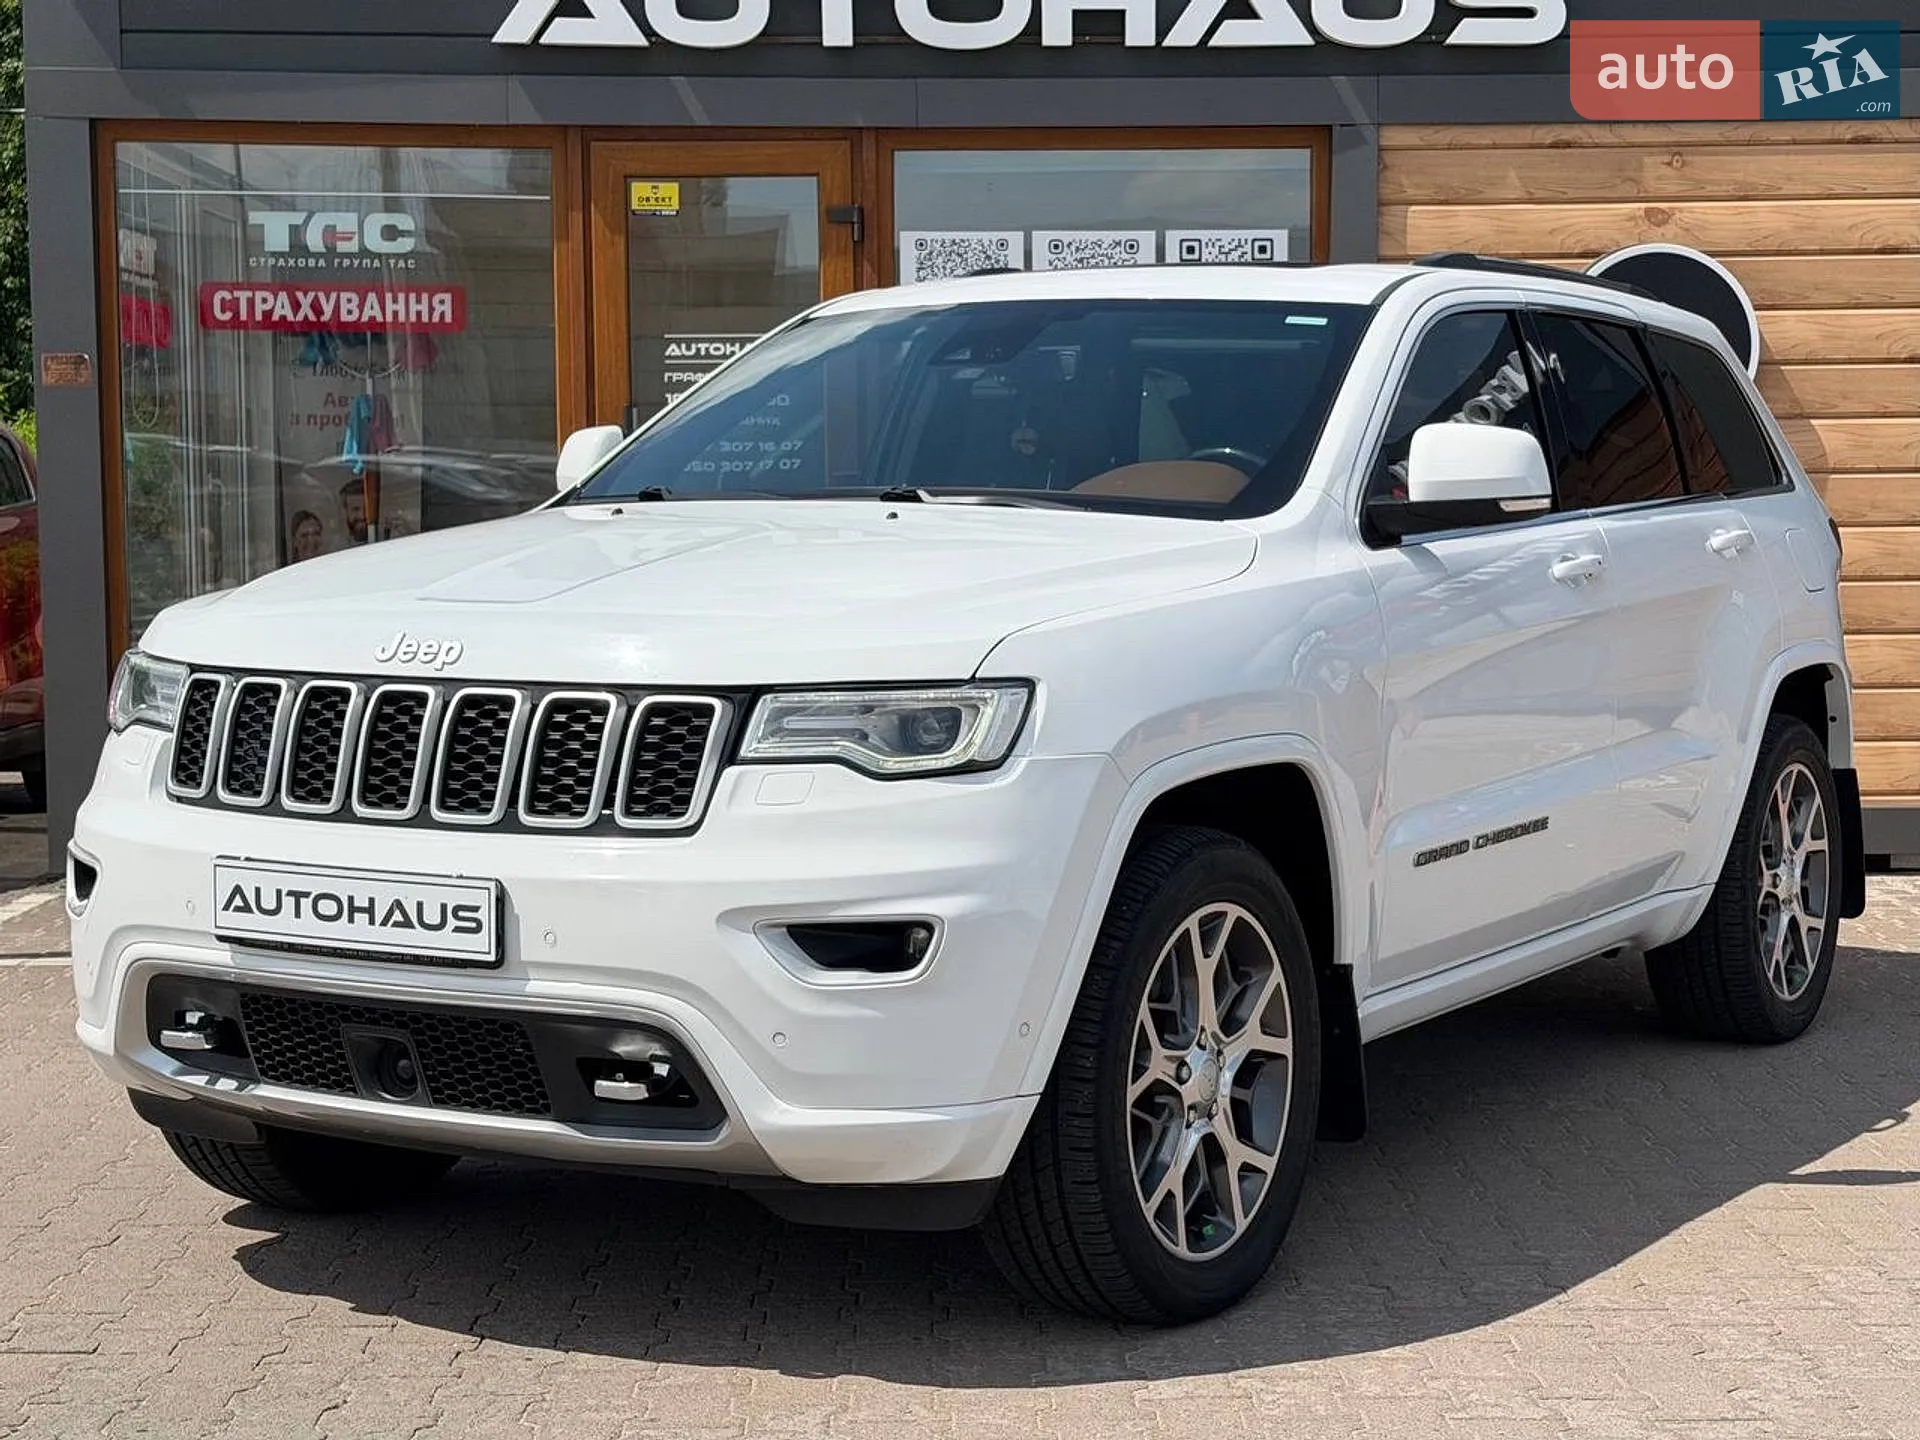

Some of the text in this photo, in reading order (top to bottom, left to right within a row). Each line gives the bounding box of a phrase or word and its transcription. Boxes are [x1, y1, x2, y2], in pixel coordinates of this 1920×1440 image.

[249, 256, 417, 269] СТРАХОВА ГРУПА ТАС
[212, 290, 453, 324] СТРАХУВАННЯ
[374, 629, 464, 671] Jeep
[1413, 815, 1550, 868] GRAND CHEROKEE
[221, 883, 484, 935] AUTOHAUS
